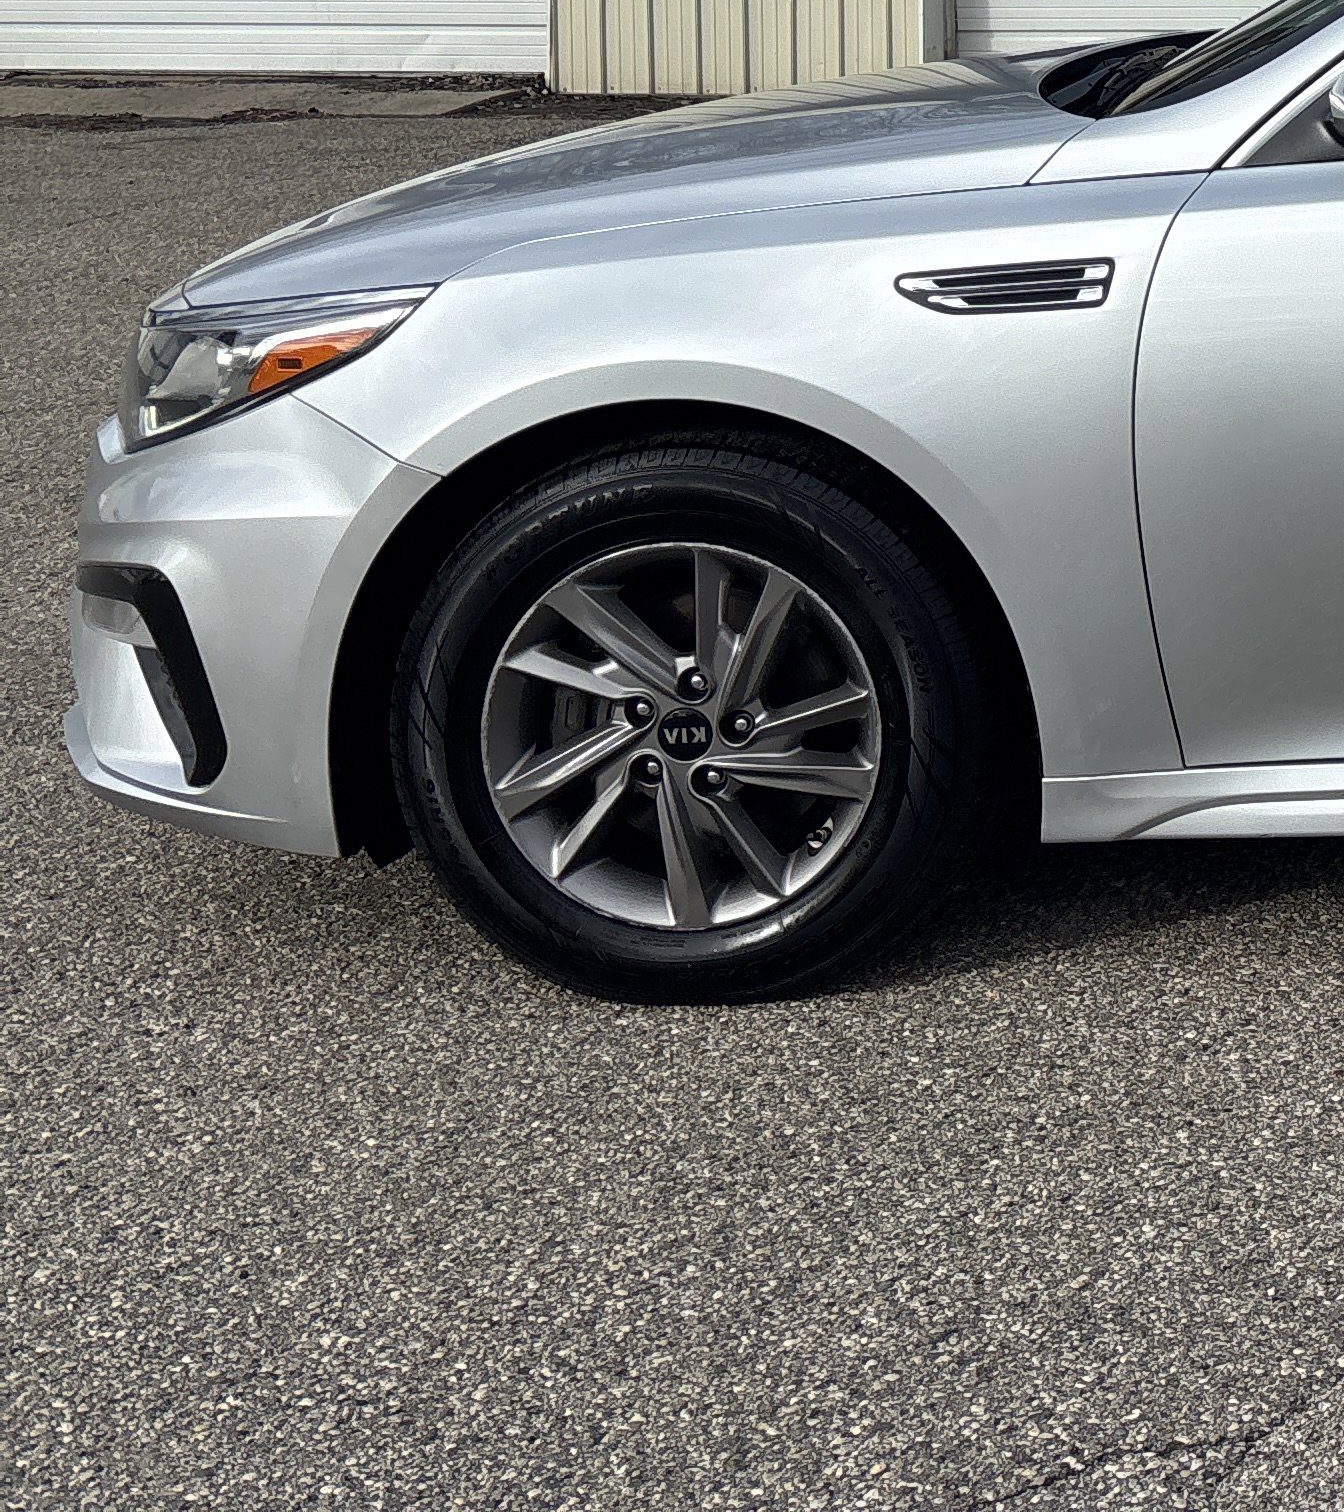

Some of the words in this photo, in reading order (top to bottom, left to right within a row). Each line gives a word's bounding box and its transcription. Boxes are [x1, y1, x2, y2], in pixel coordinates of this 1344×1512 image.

[855, 566, 888, 600] ALL
[886, 604, 935, 694] SEASON
[663, 726, 707, 744] KIA
